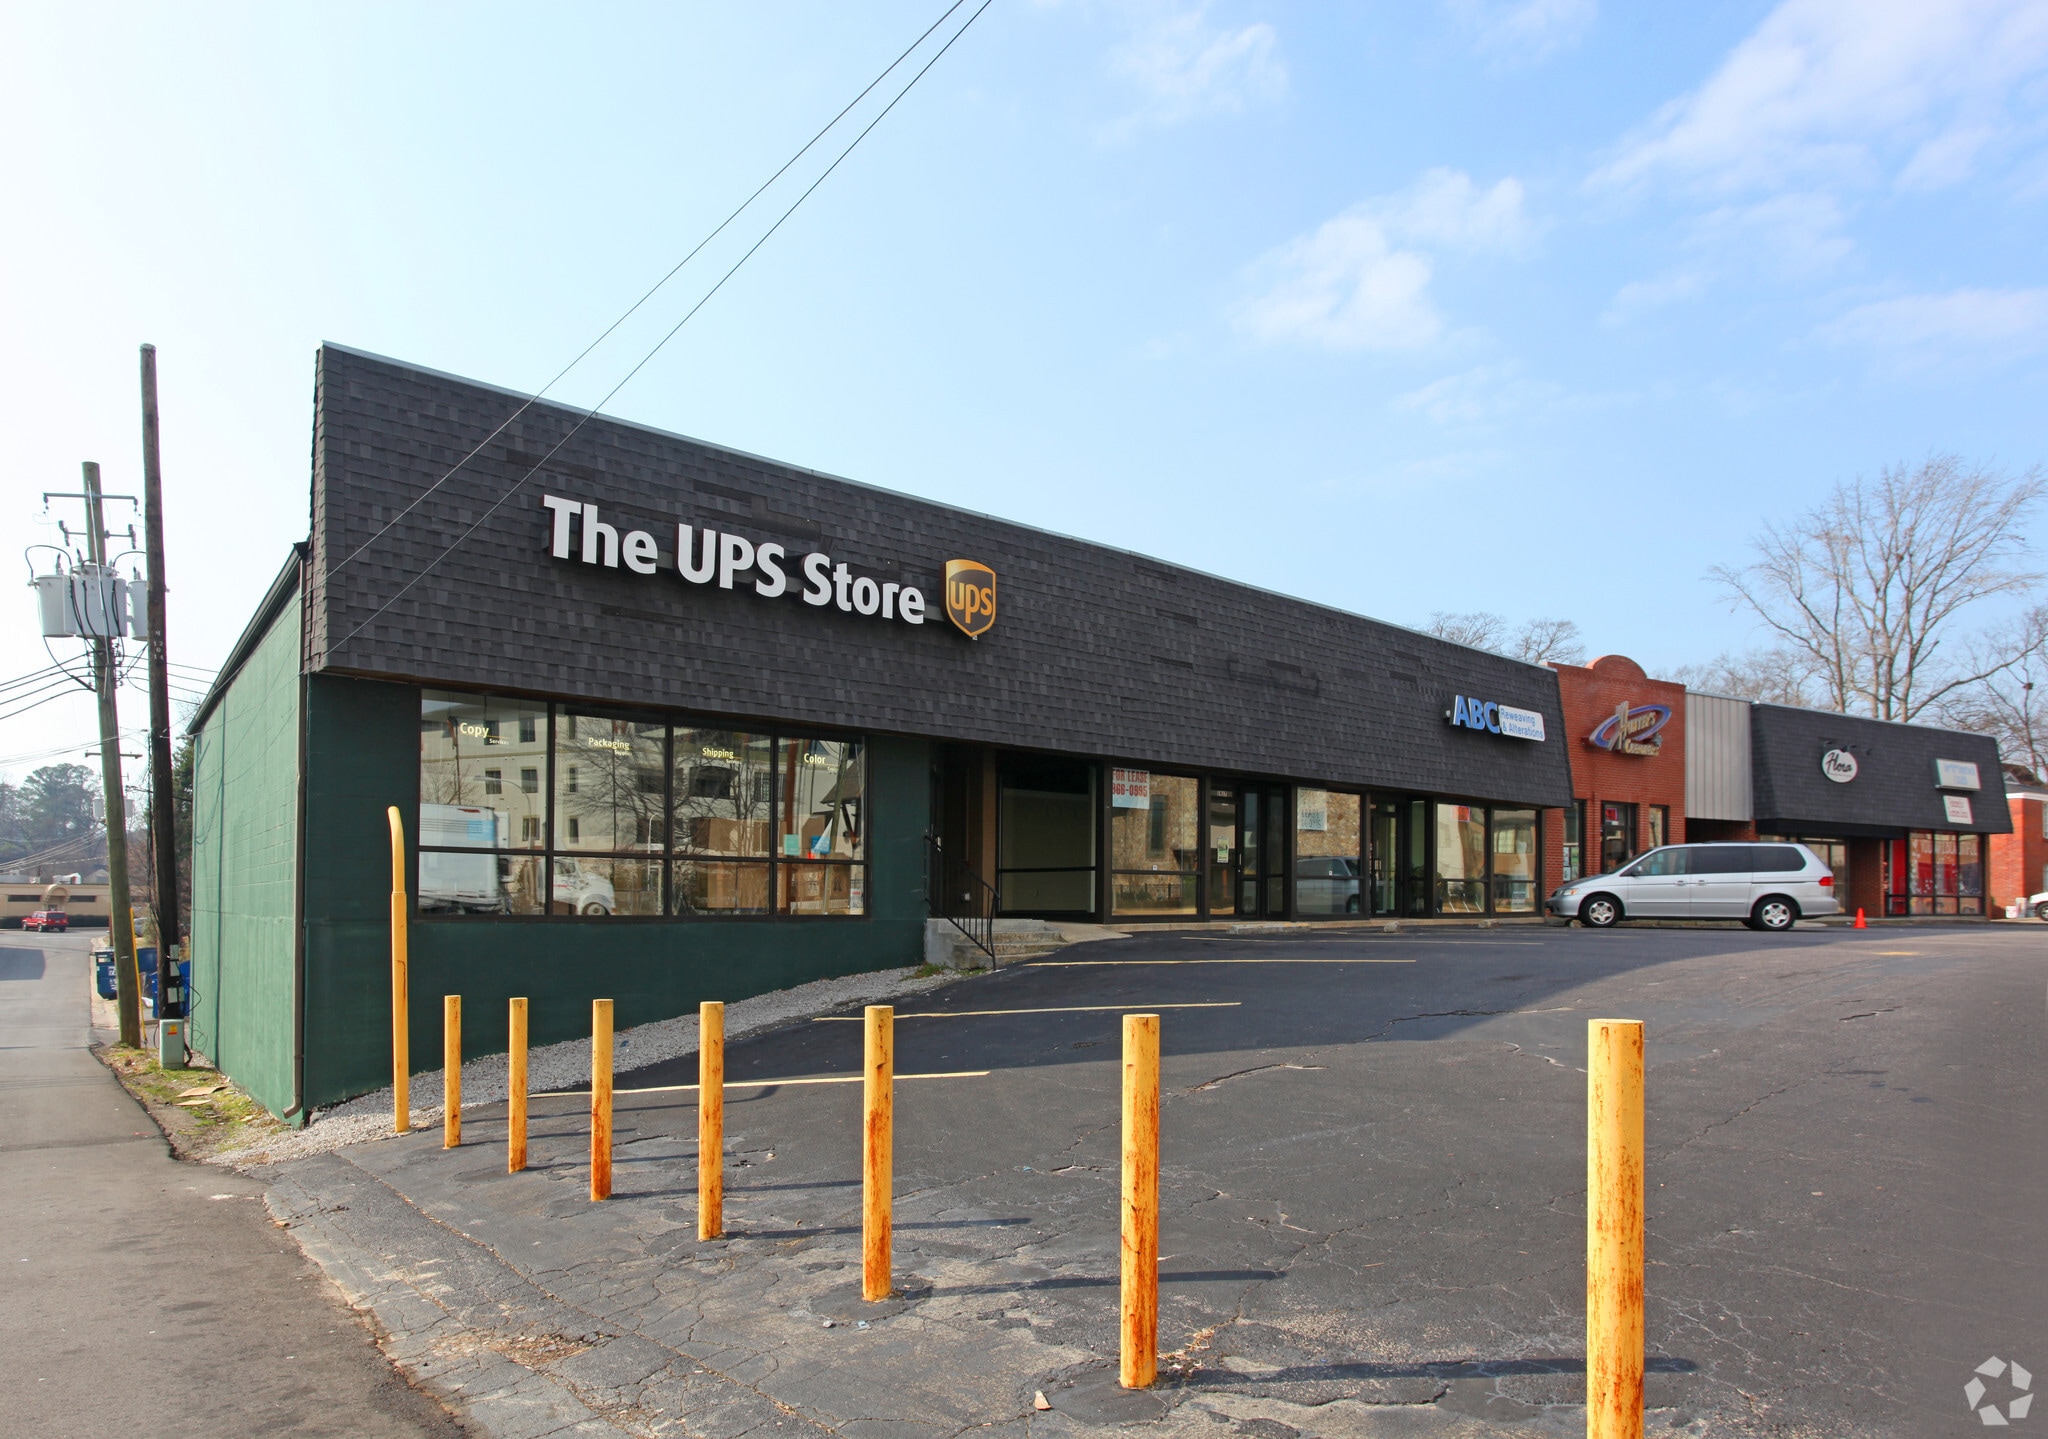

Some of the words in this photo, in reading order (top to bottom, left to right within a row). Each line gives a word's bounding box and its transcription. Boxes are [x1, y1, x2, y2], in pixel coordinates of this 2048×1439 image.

[543, 494, 658, 574] The
[677, 523, 787, 598] UPS
[803, 552, 925, 624] Store
[949, 581, 993, 623] ups
[1453, 695, 1500, 734] ABC
[1500, 707, 1536, 728] Reweaving
[459, 722, 489, 738] Copy
[1502, 722, 1508, 731] &
[1509, 722, 1544, 739] Alterations
[588, 737, 630, 751] Packaging
[702, 747, 734, 760] Shipping
[803, 753, 826, 764] Color
[1825, 752, 1853, 774] Flora
[1128, 770, 1148, 784] LEASE
